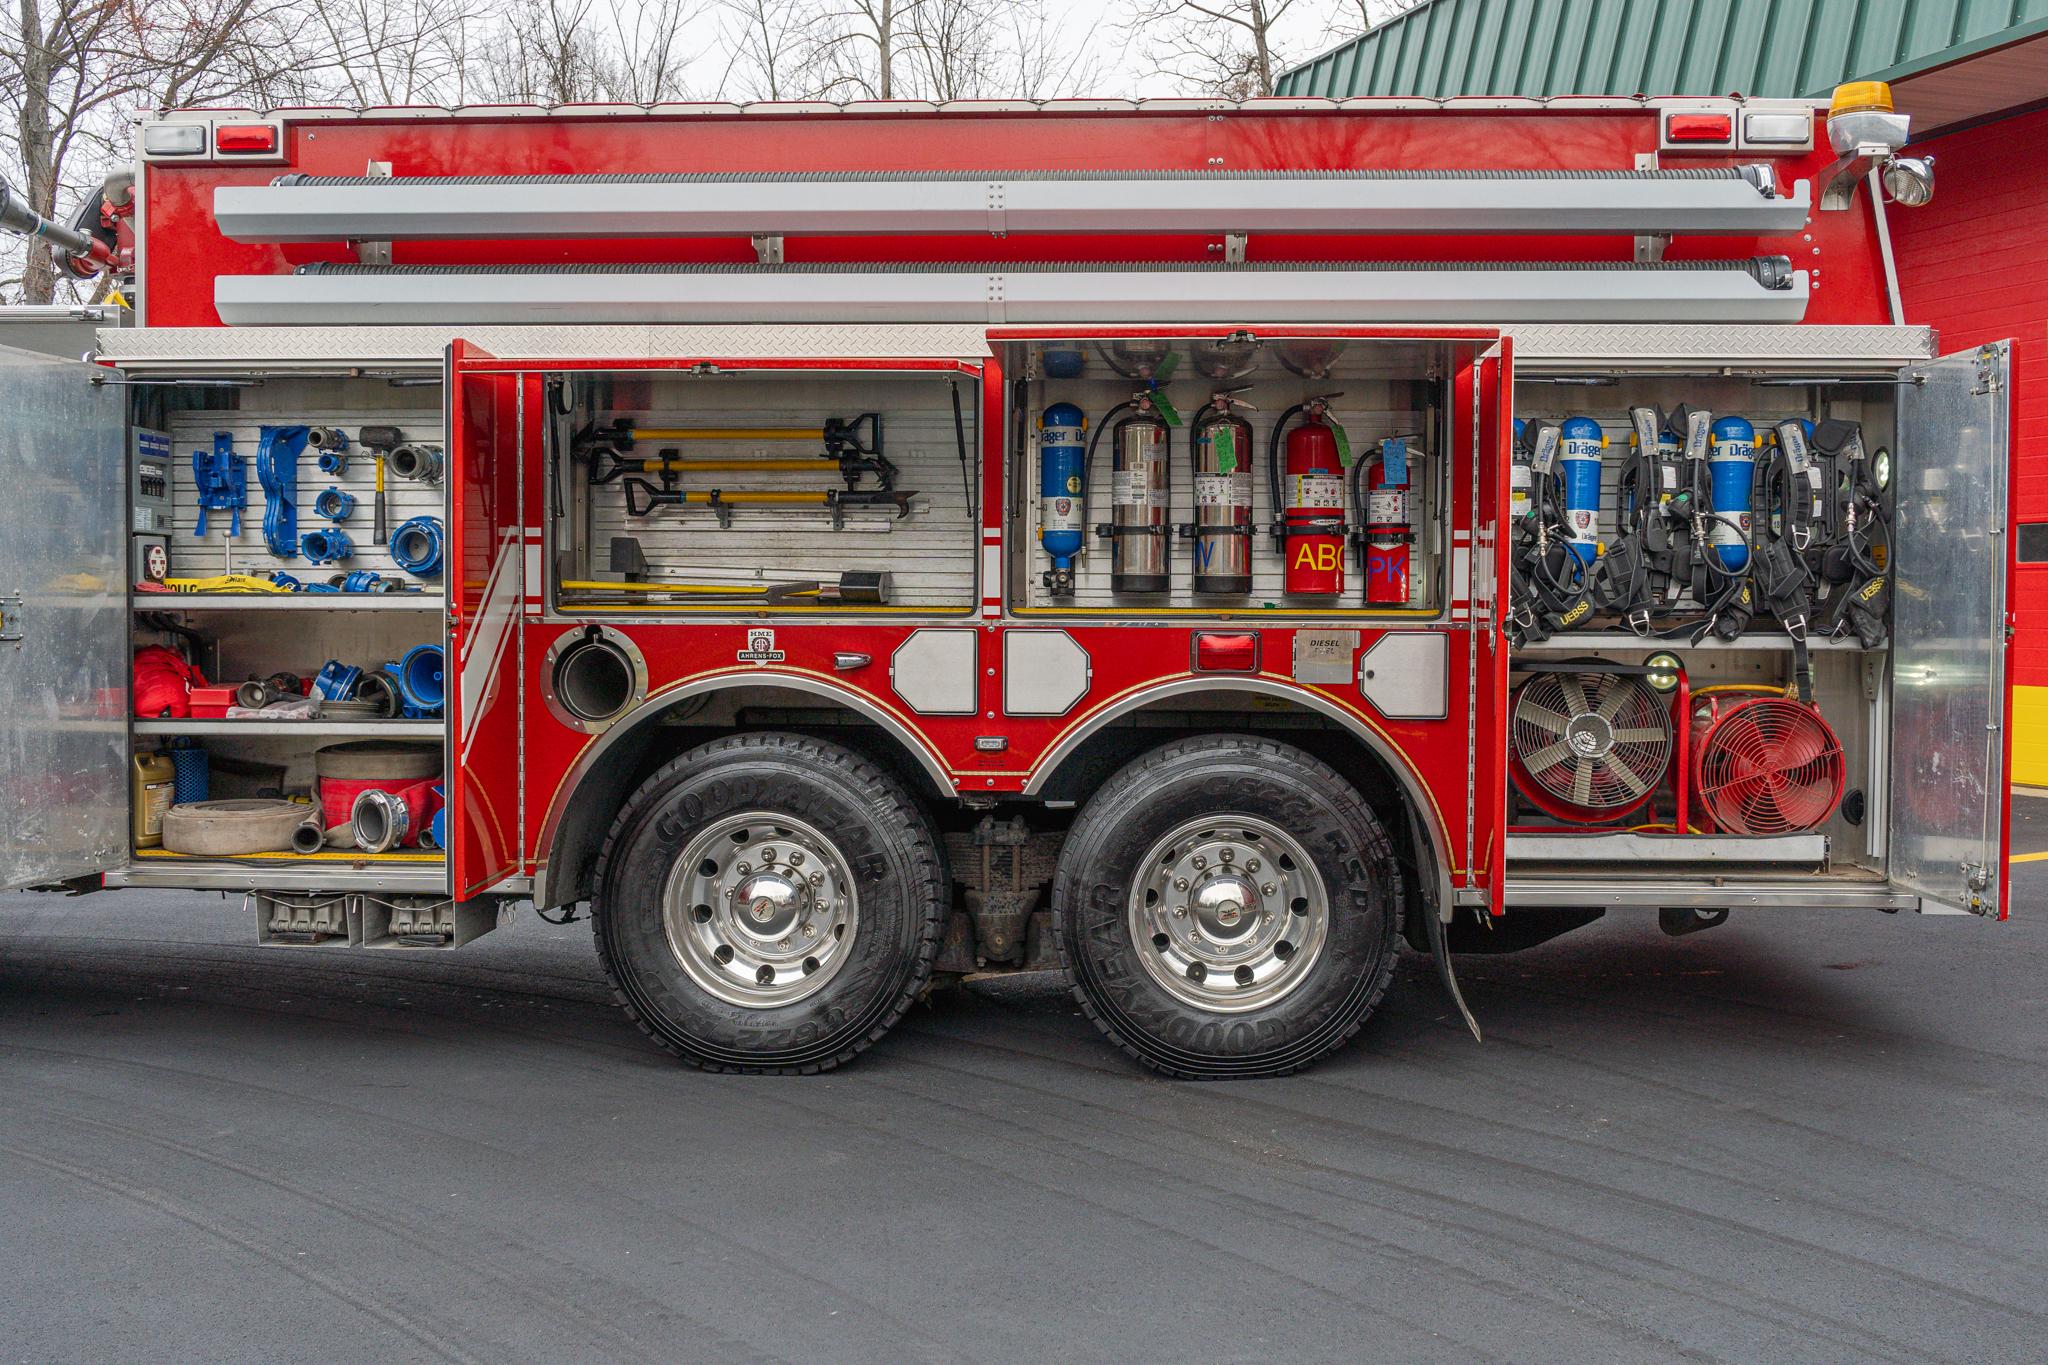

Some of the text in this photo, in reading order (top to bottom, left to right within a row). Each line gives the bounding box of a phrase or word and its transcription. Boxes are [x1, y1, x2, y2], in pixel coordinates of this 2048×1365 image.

[1041, 429, 1067, 444] räger
[1694, 420, 1706, 448] Dräger
[1540, 435, 1555, 463] Dräger
[1792, 435, 1804, 463] Dräger
[1368, 555, 1406, 585] PK
[1860, 577, 1885, 601] UEBSS
[1559, 601, 1589, 625] UEBSS
[655, 776, 889, 883] GOODYEAR
